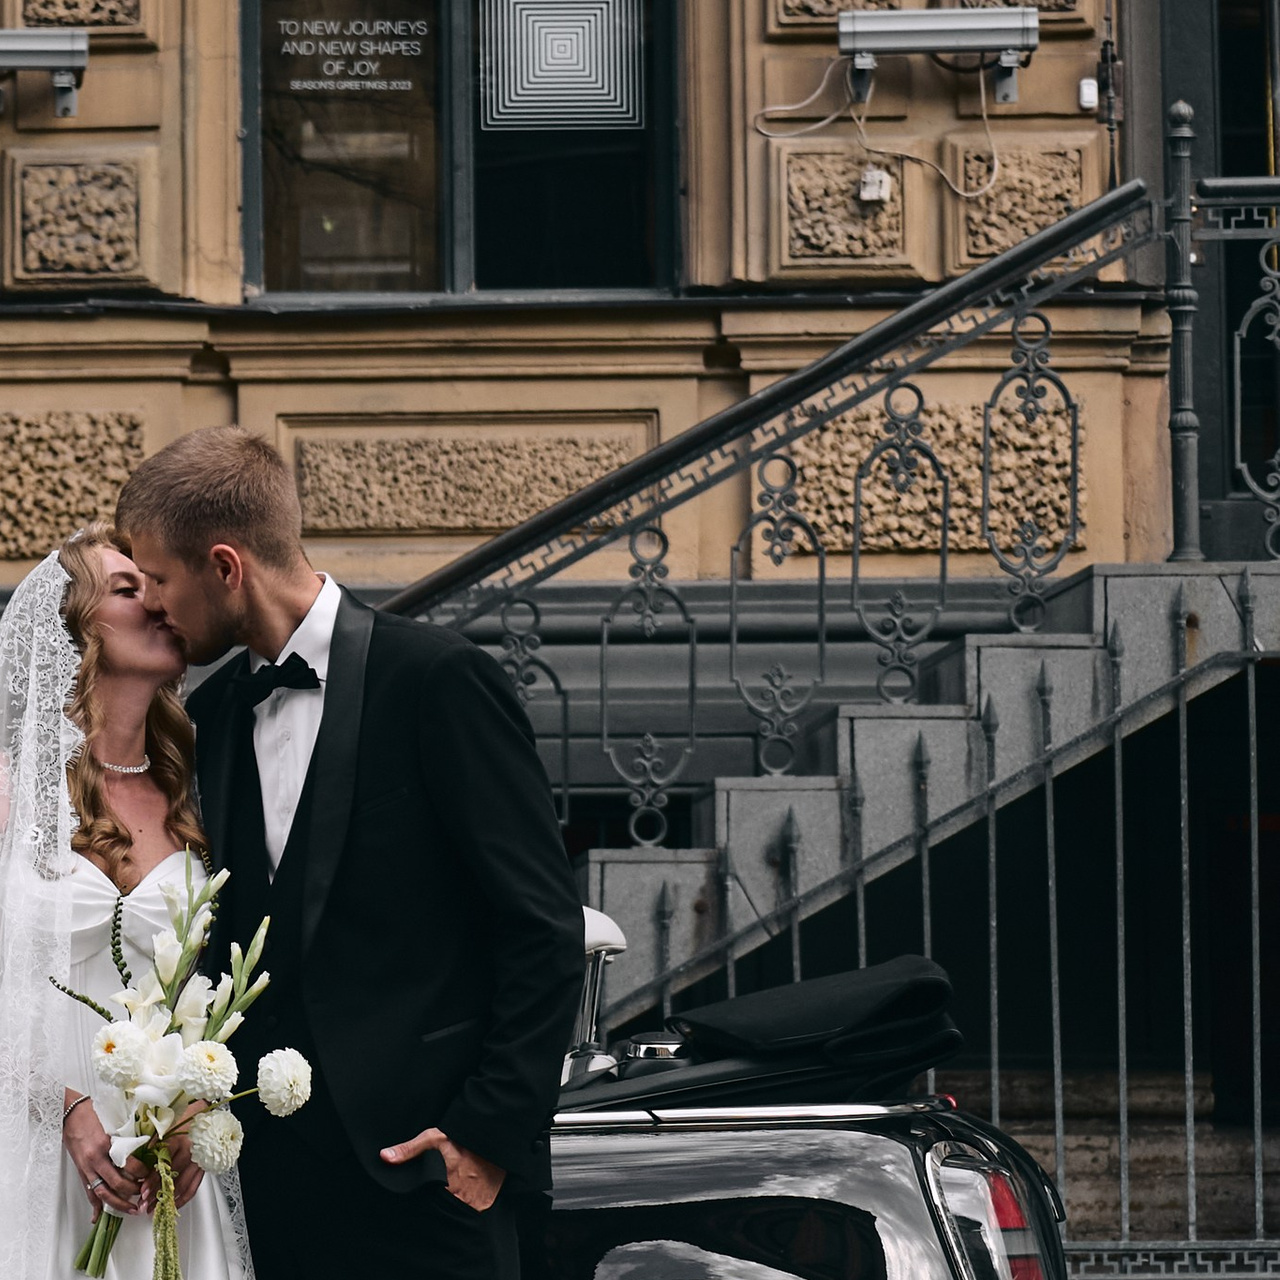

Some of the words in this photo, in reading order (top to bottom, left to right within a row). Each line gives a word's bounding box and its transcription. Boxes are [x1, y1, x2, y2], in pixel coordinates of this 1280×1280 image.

[277, 20, 300, 36] TO
[302, 20, 342, 36] NEW
[342, 20, 428, 36] JOURNEYS
[280, 40, 316, 56] AND
[318, 40, 357, 56] NEW
[359, 40, 422, 56] SHAPES
[322, 60, 346, 76] OF
